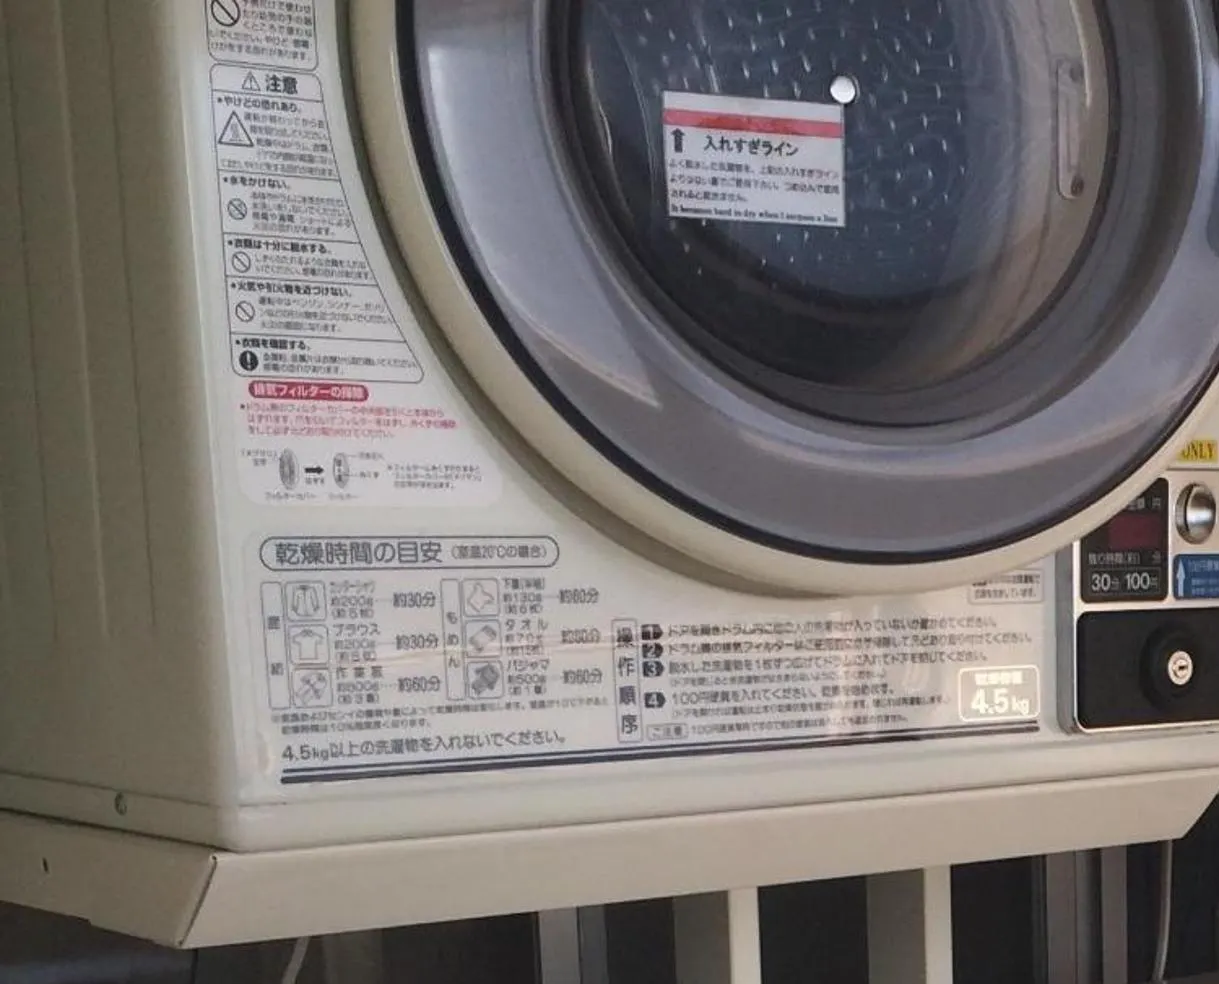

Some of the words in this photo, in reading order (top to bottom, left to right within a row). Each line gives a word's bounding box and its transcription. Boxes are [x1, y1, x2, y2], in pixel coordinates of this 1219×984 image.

[265, 73, 298, 94] 注意
[703, 135, 799, 157] 入れすぎライン
[275, 541, 443, 566] 乾燥時間の目安
